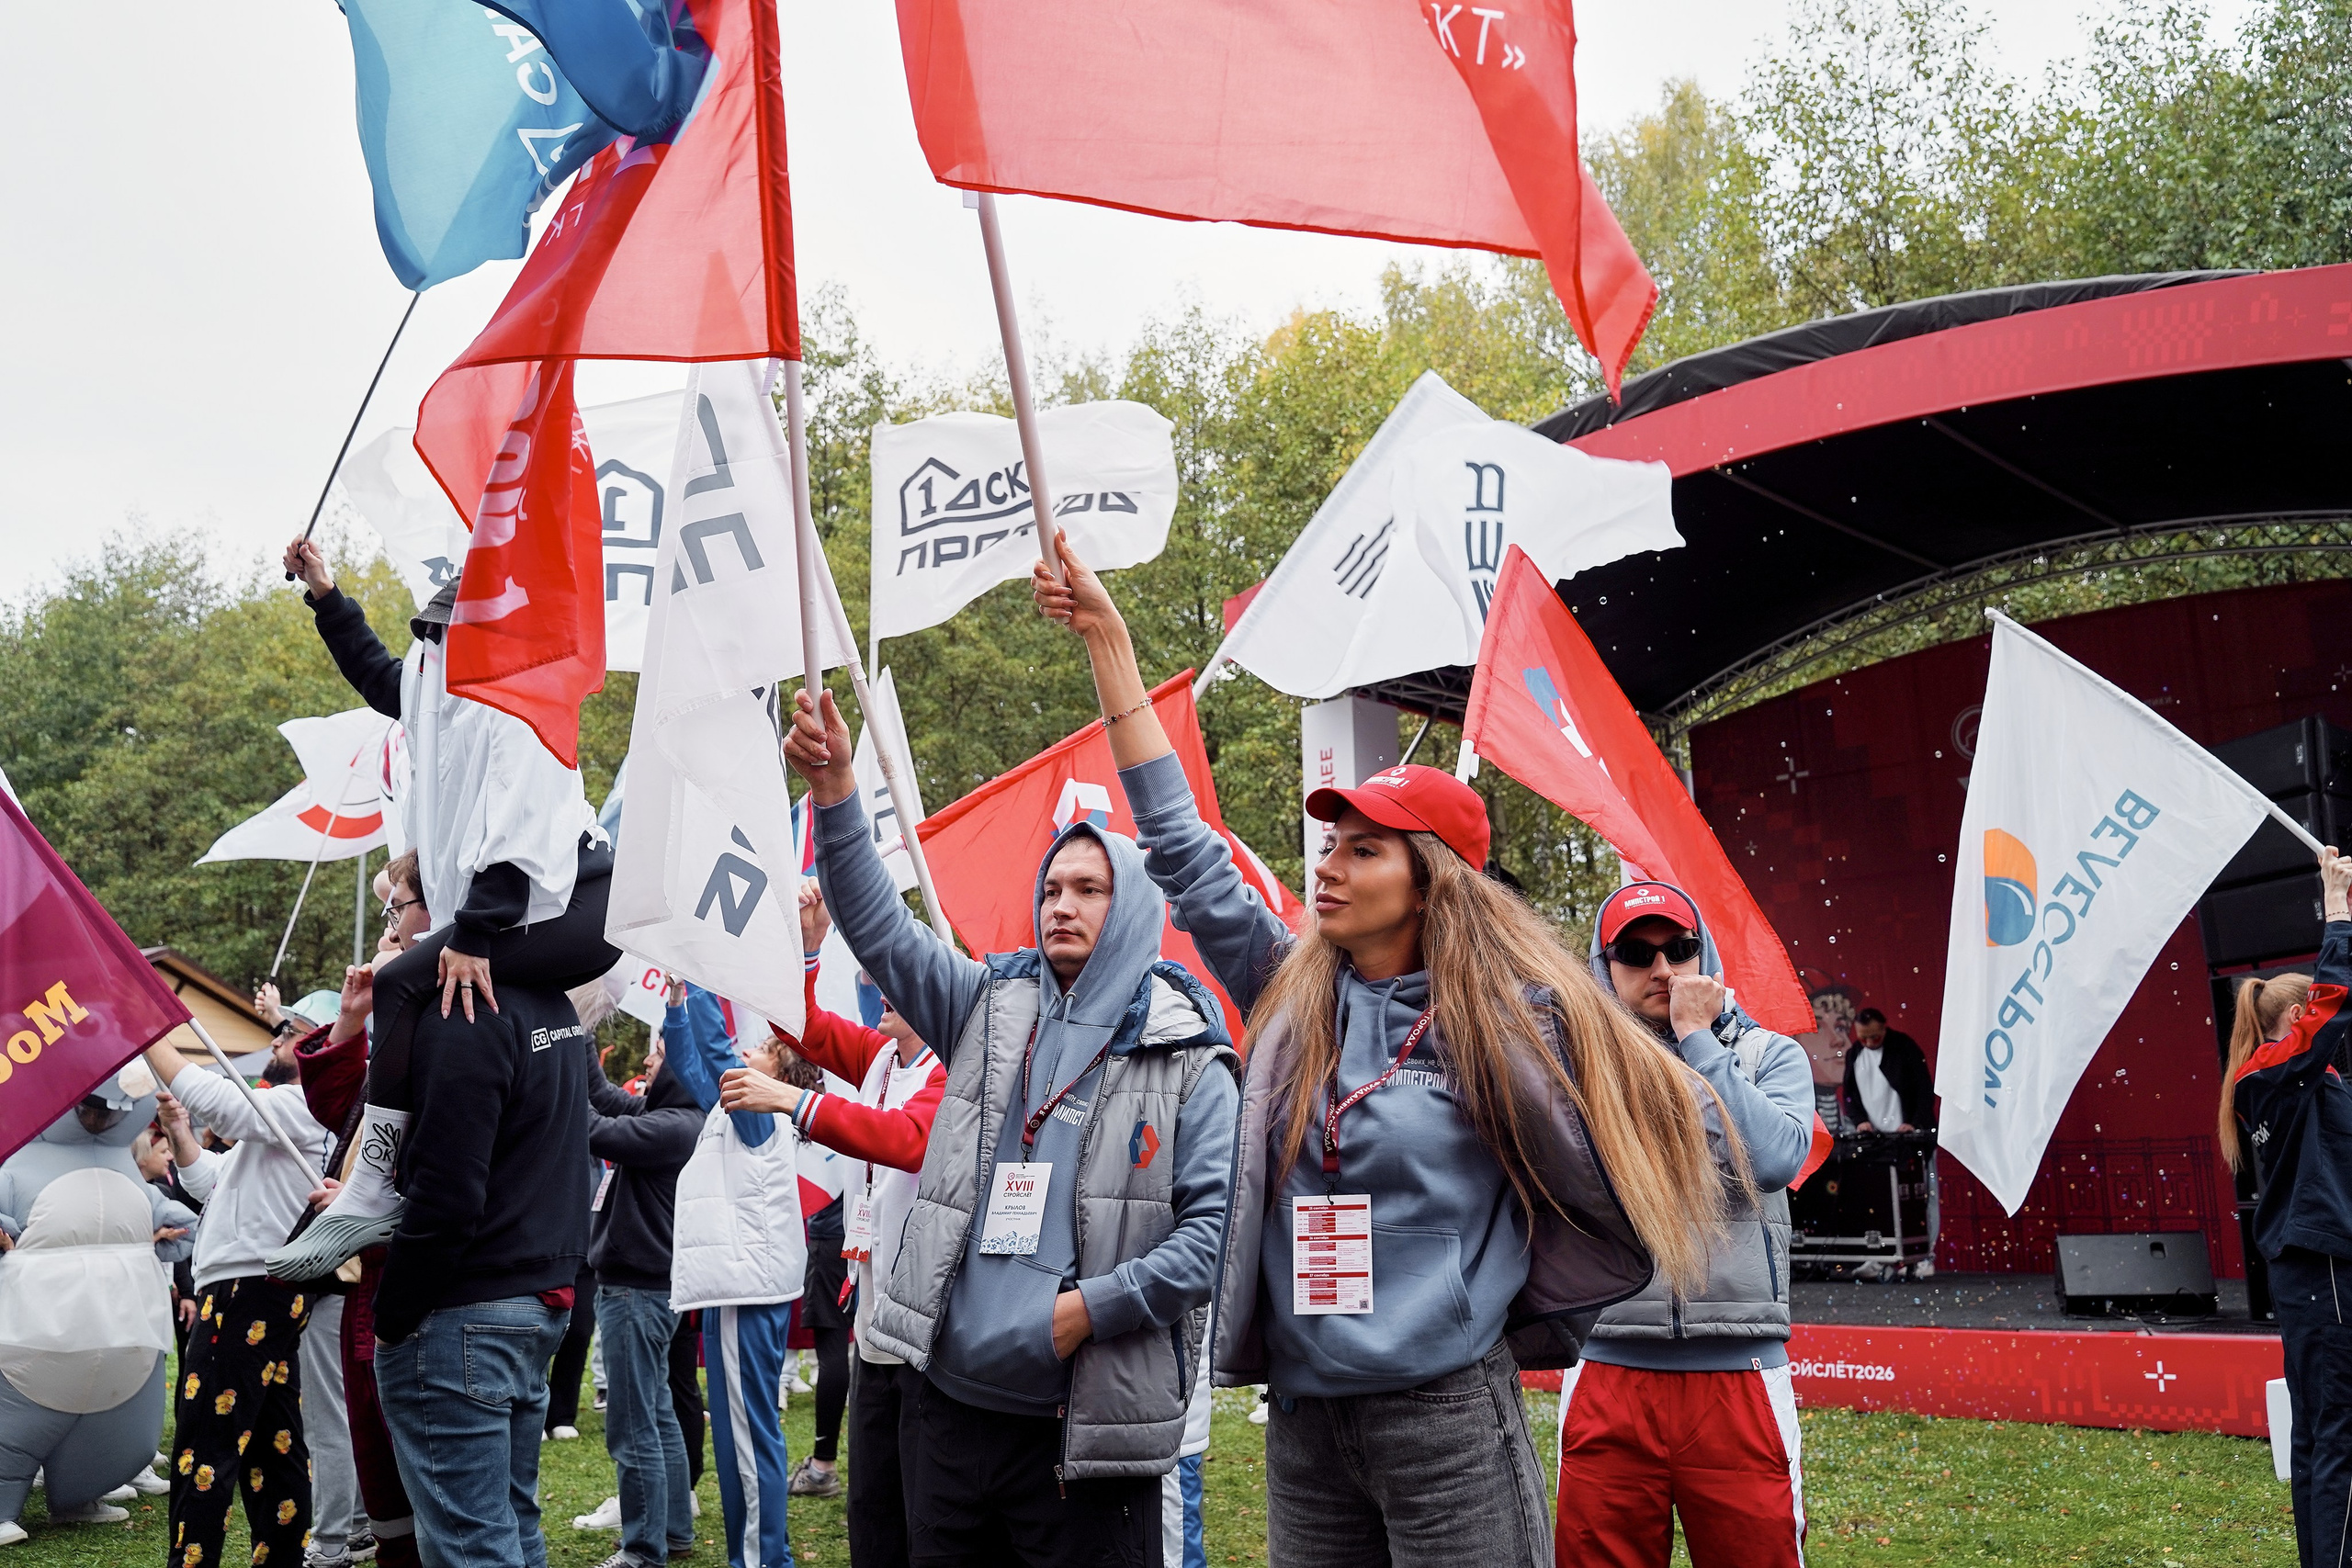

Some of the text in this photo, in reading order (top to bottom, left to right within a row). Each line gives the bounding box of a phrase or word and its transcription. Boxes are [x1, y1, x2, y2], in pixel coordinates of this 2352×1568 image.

[1623, 895, 1660, 908] МИПСТРОЙ
[1661, 895, 1666, 903] 1
[534, 1024, 585, 1046] CG CAPITAL GRO
[1405, 1015, 1430, 1046] ГОРОДА
[366, 1144, 395, 1162] OK
[1004, 1180, 1035, 1192] XVIII
